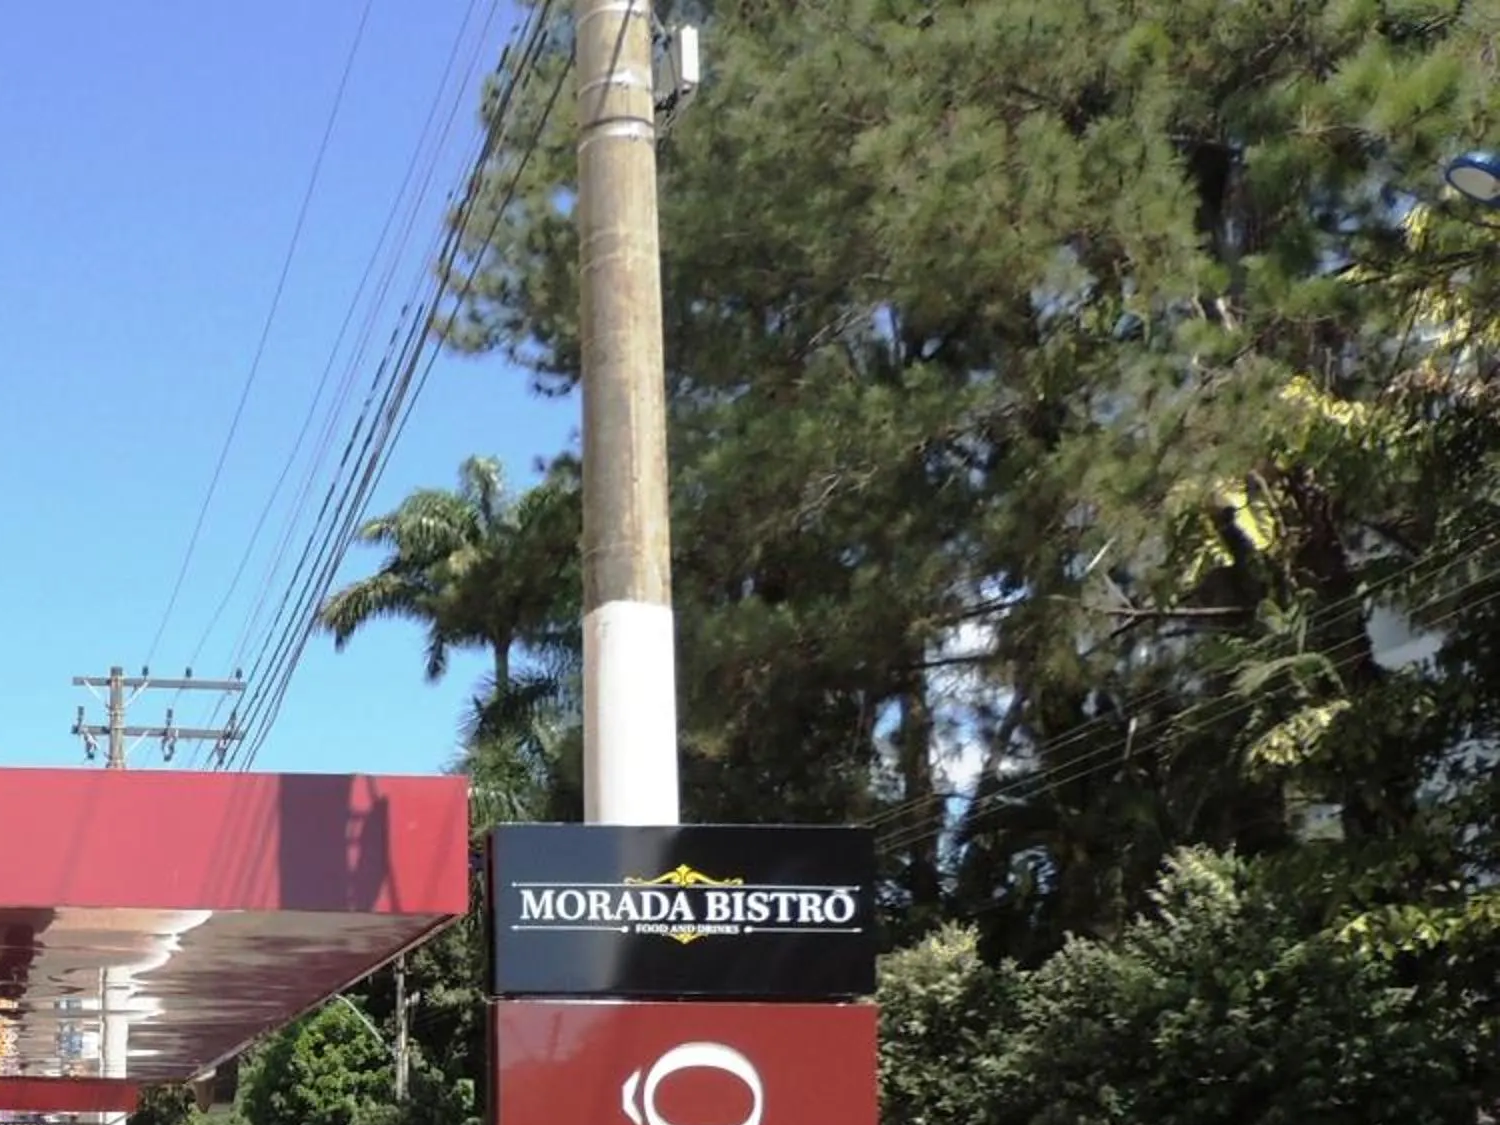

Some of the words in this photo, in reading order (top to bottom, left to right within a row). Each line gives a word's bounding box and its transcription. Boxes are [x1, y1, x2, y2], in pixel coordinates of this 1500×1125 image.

[519, 888, 696, 921] MORADA
[704, 888, 856, 923] BISTRÔ
[635, 923, 668, 934] FOOD
[671, 923, 695, 934] AND
[697, 923, 740, 935] DRINKS
